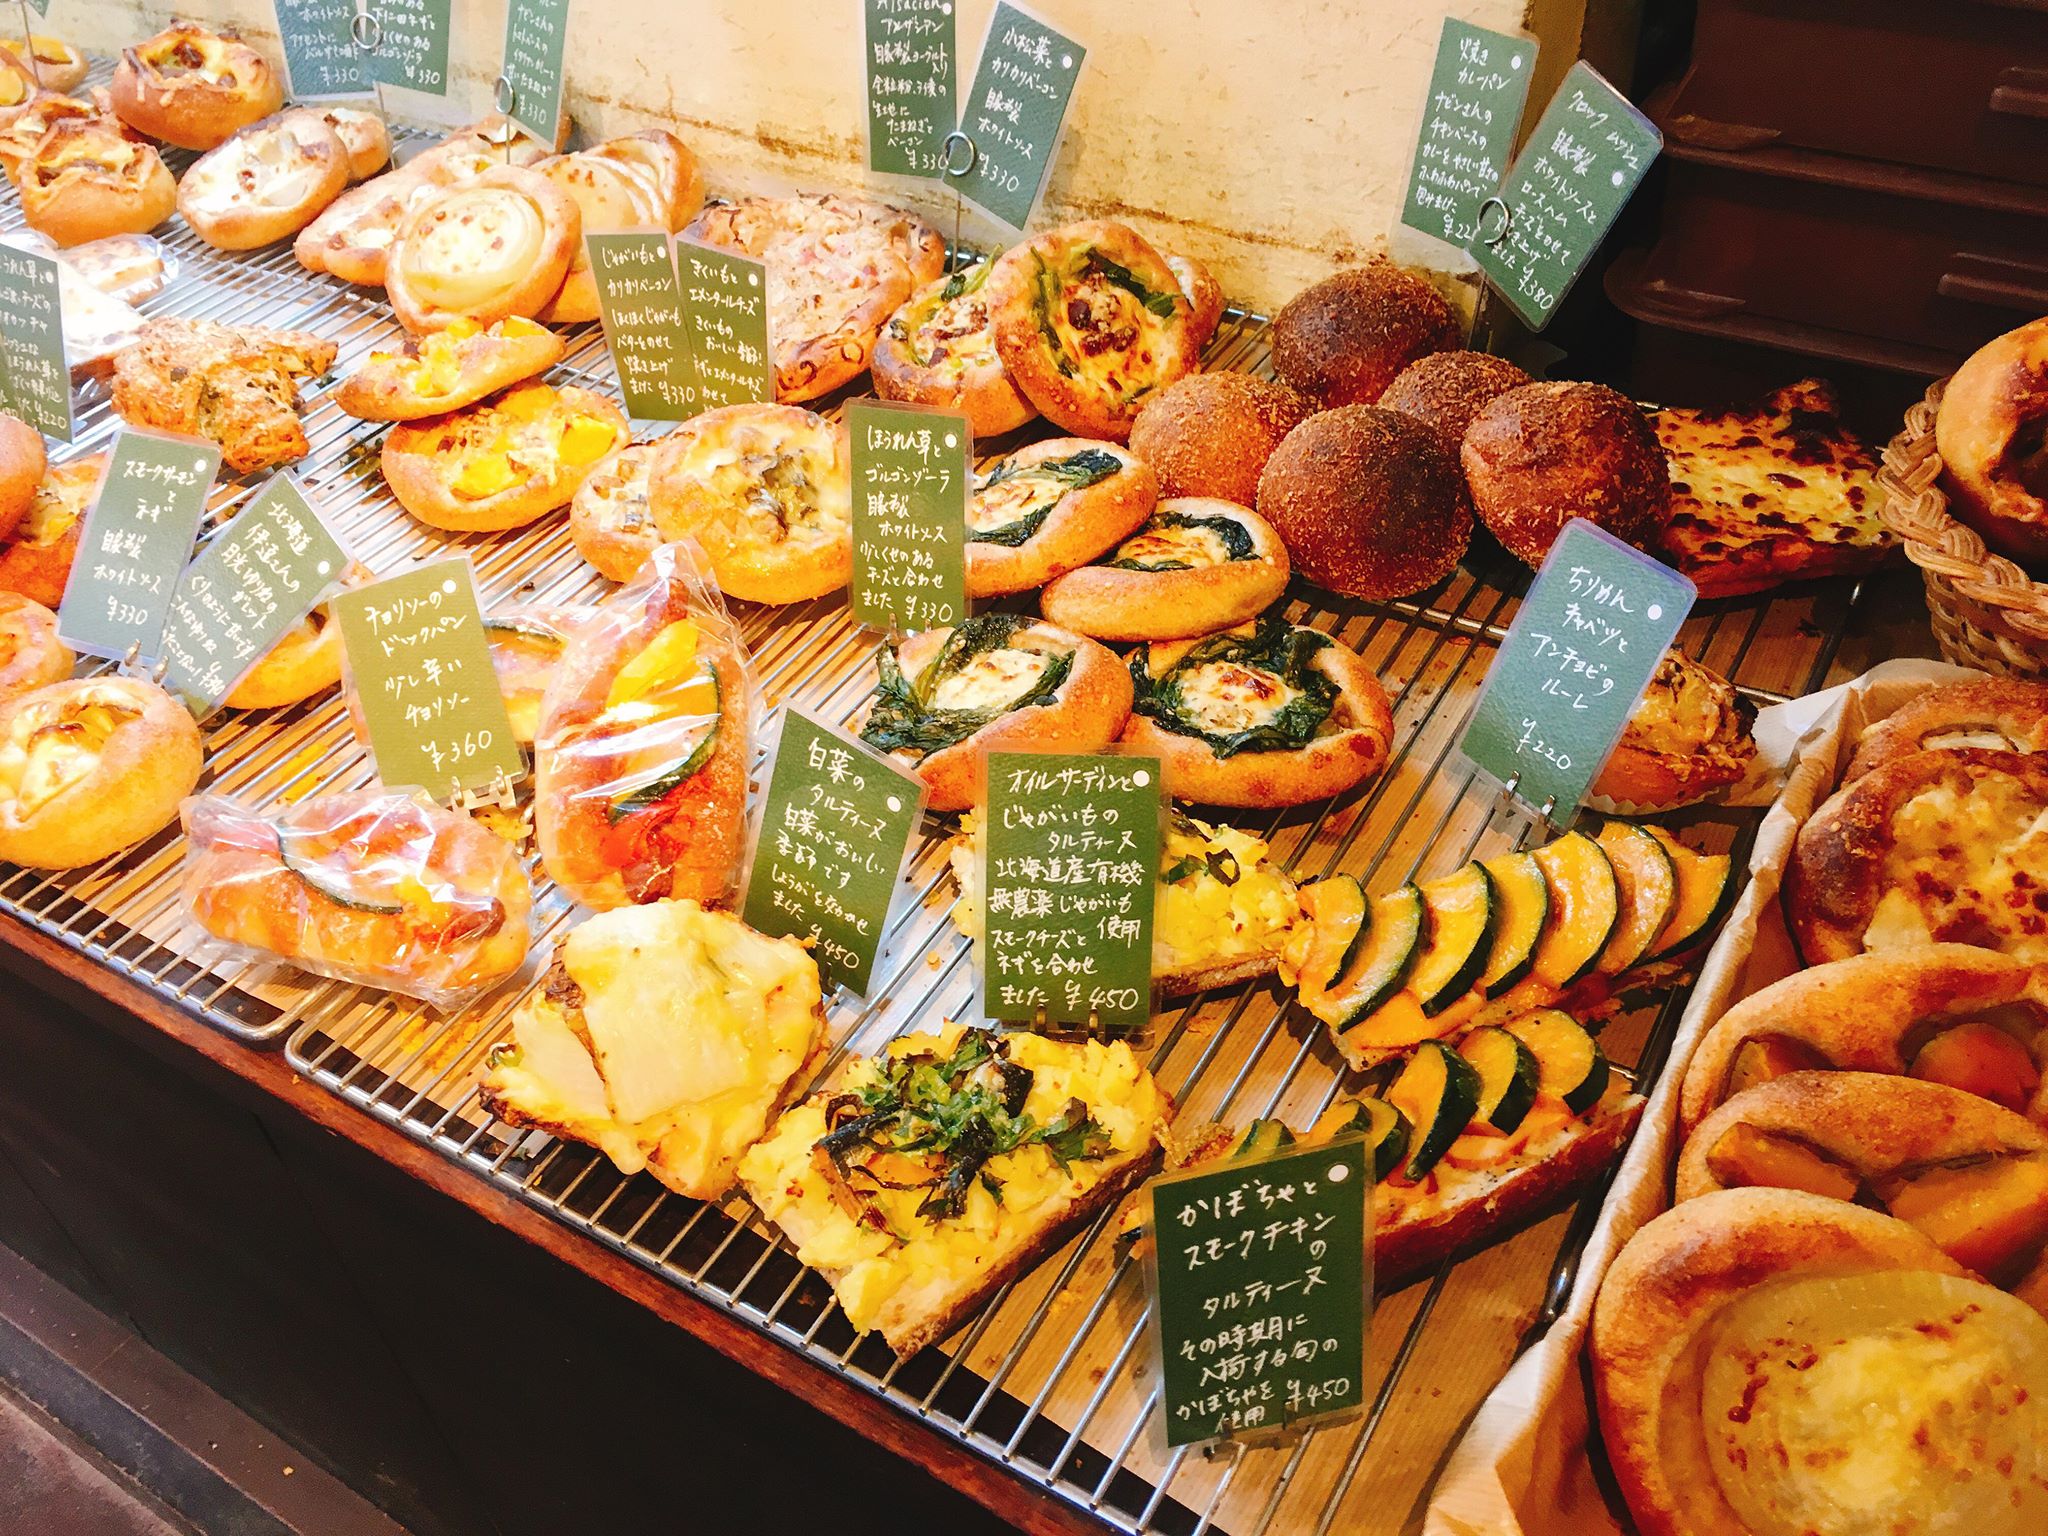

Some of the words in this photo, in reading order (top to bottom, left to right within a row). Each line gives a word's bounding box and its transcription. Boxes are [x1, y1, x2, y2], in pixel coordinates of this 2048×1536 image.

[1002, 26, 1053, 69] 小松菜と
[1459, 37, 1489, 67] 焼き
[991, 57, 1058, 99] カリカリベーコン
[1457, 67, 1511, 90] カレーパン
[1435, 91, 1492, 125] ナビンさんの
[1567, 89, 1609, 130] クロック
[887, 137, 924, 147] ベーコン
[1430, 116, 1487, 151] チキンベースの
[1521, 181, 1568, 228] ロースハム
[1533, 155, 1597, 225] ホワイトソースと
[0, 254, 45, 288] うれん草と
[602, 243, 656, 269] じゃがいもと
[690, 258, 739, 285] きくいもと
[607, 277, 672, 298] カリカリベーコン
[689, 288, 760, 317] エメンタールチーズ
[1518, 265, 1554, 310] ¥380
[617, 334, 673, 352] バターをのせて
[695, 315, 733, 340] きくいもの
[867, 424, 942, 466] ほうれん草と
[123, 460, 198, 486] スモークサーモン
[865, 463, 951, 494] ゴルゴンゾーラ
[135, 498, 173, 523] ネギ
[167, 490, 177, 503] と
[267, 501, 313, 556] 北海道
[866, 565, 944, 590] チーズと合わせ
[1567, 565, 1635, 614] ちりめん
[231, 590, 267, 630] ガレット
[363, 591, 443, 636] チョリソーの
[860, 589, 894, 610] ました
[381, 615, 467, 657] ドックパン
[1561, 602, 1630, 654] キャベツと
[1530, 632, 1616, 697] アンチョビの
[404, 693, 470, 728] チョリソー
[1540, 677, 1590, 710] ルーレ
[421, 730, 492, 772] ¥360
[1516, 717, 1572, 771] ¥220
[808, 736, 865, 792] 白菜の
[1007, 764, 1134, 797] オイルサーディンと
[810, 783, 887, 842] タルティーヌ
[1004, 803, 1120, 829] じゃがいもの
[784, 802, 886, 875] 白菜がおいしい
[1047, 830, 1138, 855] タルティーヌ
[994, 855, 1146, 887] 北海道産有機
[771, 889, 806, 923] ました
[990, 928, 1088, 950] スモークチーズと
[1096, 914, 1142, 949] 使用
[996, 950, 1099, 977] ネギを合わせ
[999, 983, 1050, 1007] ました
[1176, 1178, 1318, 1228] かぼちゃと
[1184, 1211, 1336, 1271] スモークチキン
[1309, 1239, 1327, 1261] の
[1203, 1265, 1327, 1320] タルティーヌ
[1180, 1313, 1308, 1362] その時期に
[1199, 1337, 1339, 1388] 入荷する旬の
[1176, 1380, 1276, 1422] かぼちゃを
[1286, 1376, 1350, 1414] ¥450
